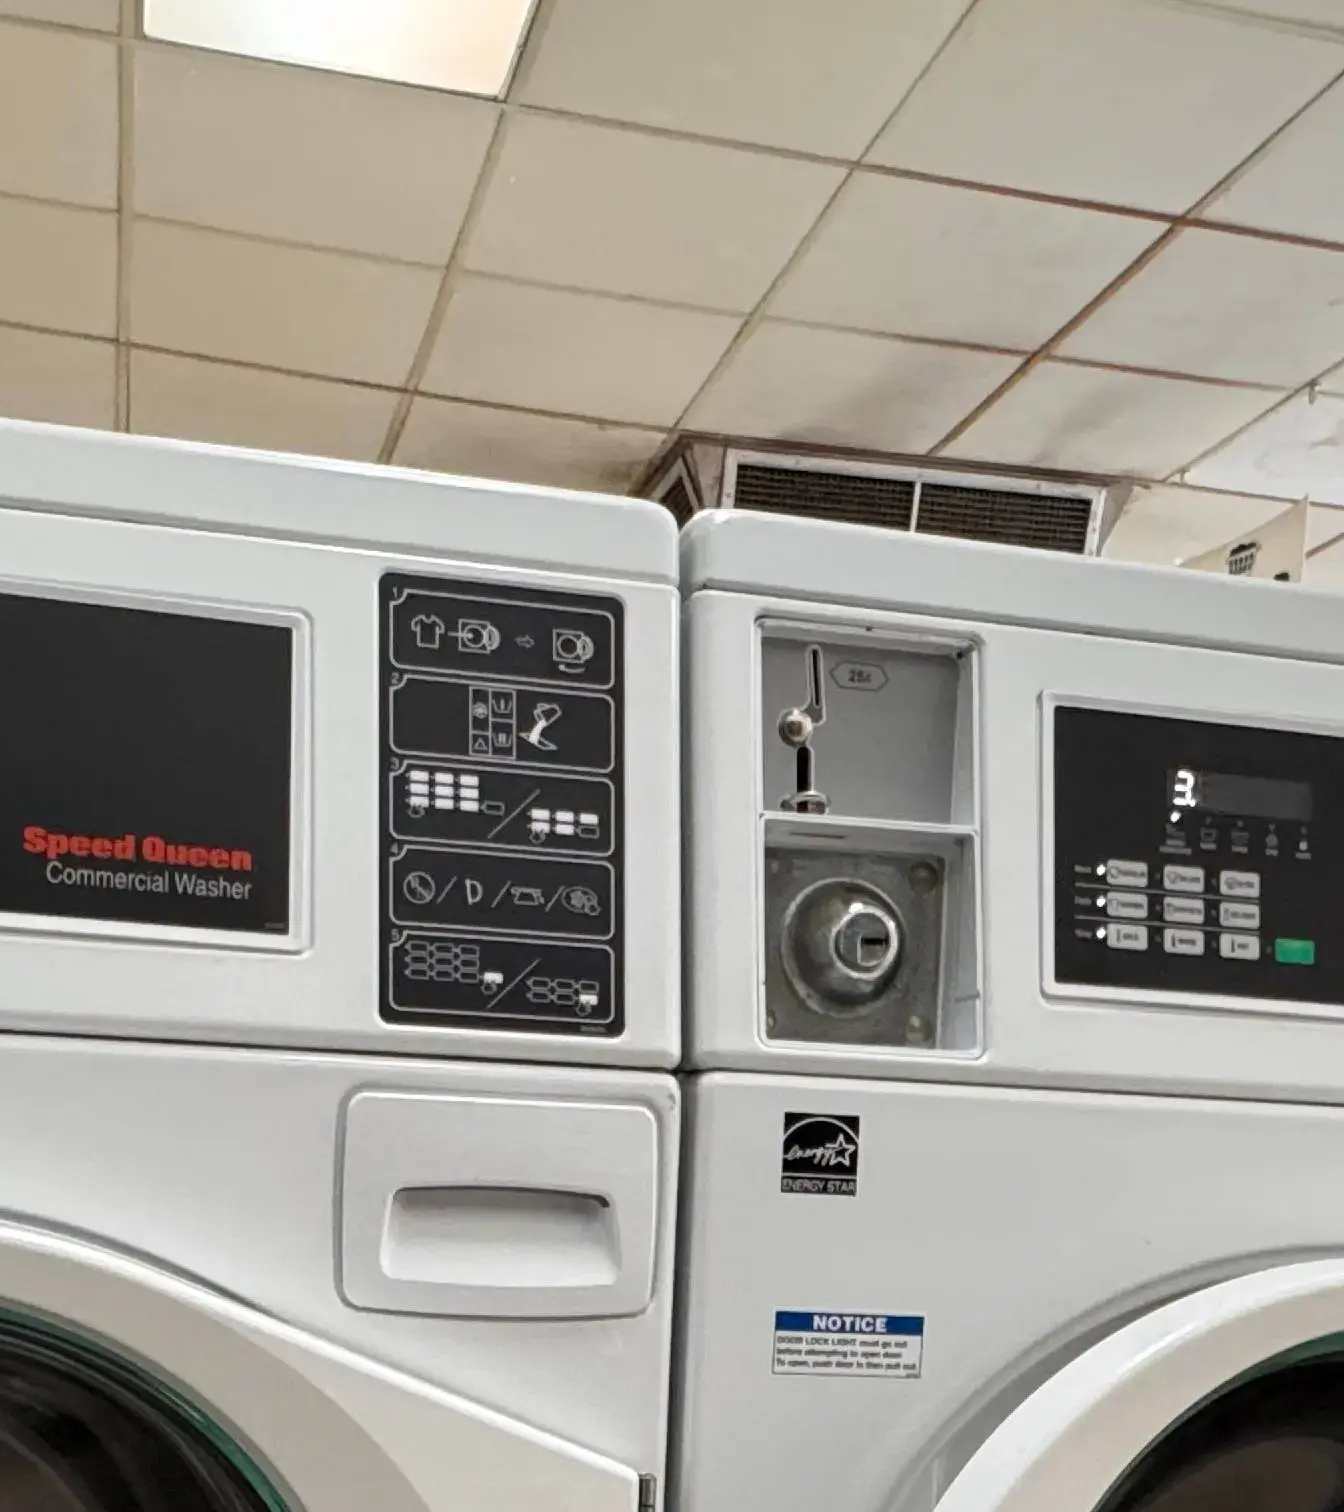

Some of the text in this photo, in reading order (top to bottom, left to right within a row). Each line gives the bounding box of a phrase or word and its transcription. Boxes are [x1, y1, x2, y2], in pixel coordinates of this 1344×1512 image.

[23, 825, 253, 871] Speed Queen
[46, 861, 253, 900] Commercial Washer
[782, 1178, 855, 1193] ENERGY STAR
[812, 1314, 888, 1333] NOTICE
